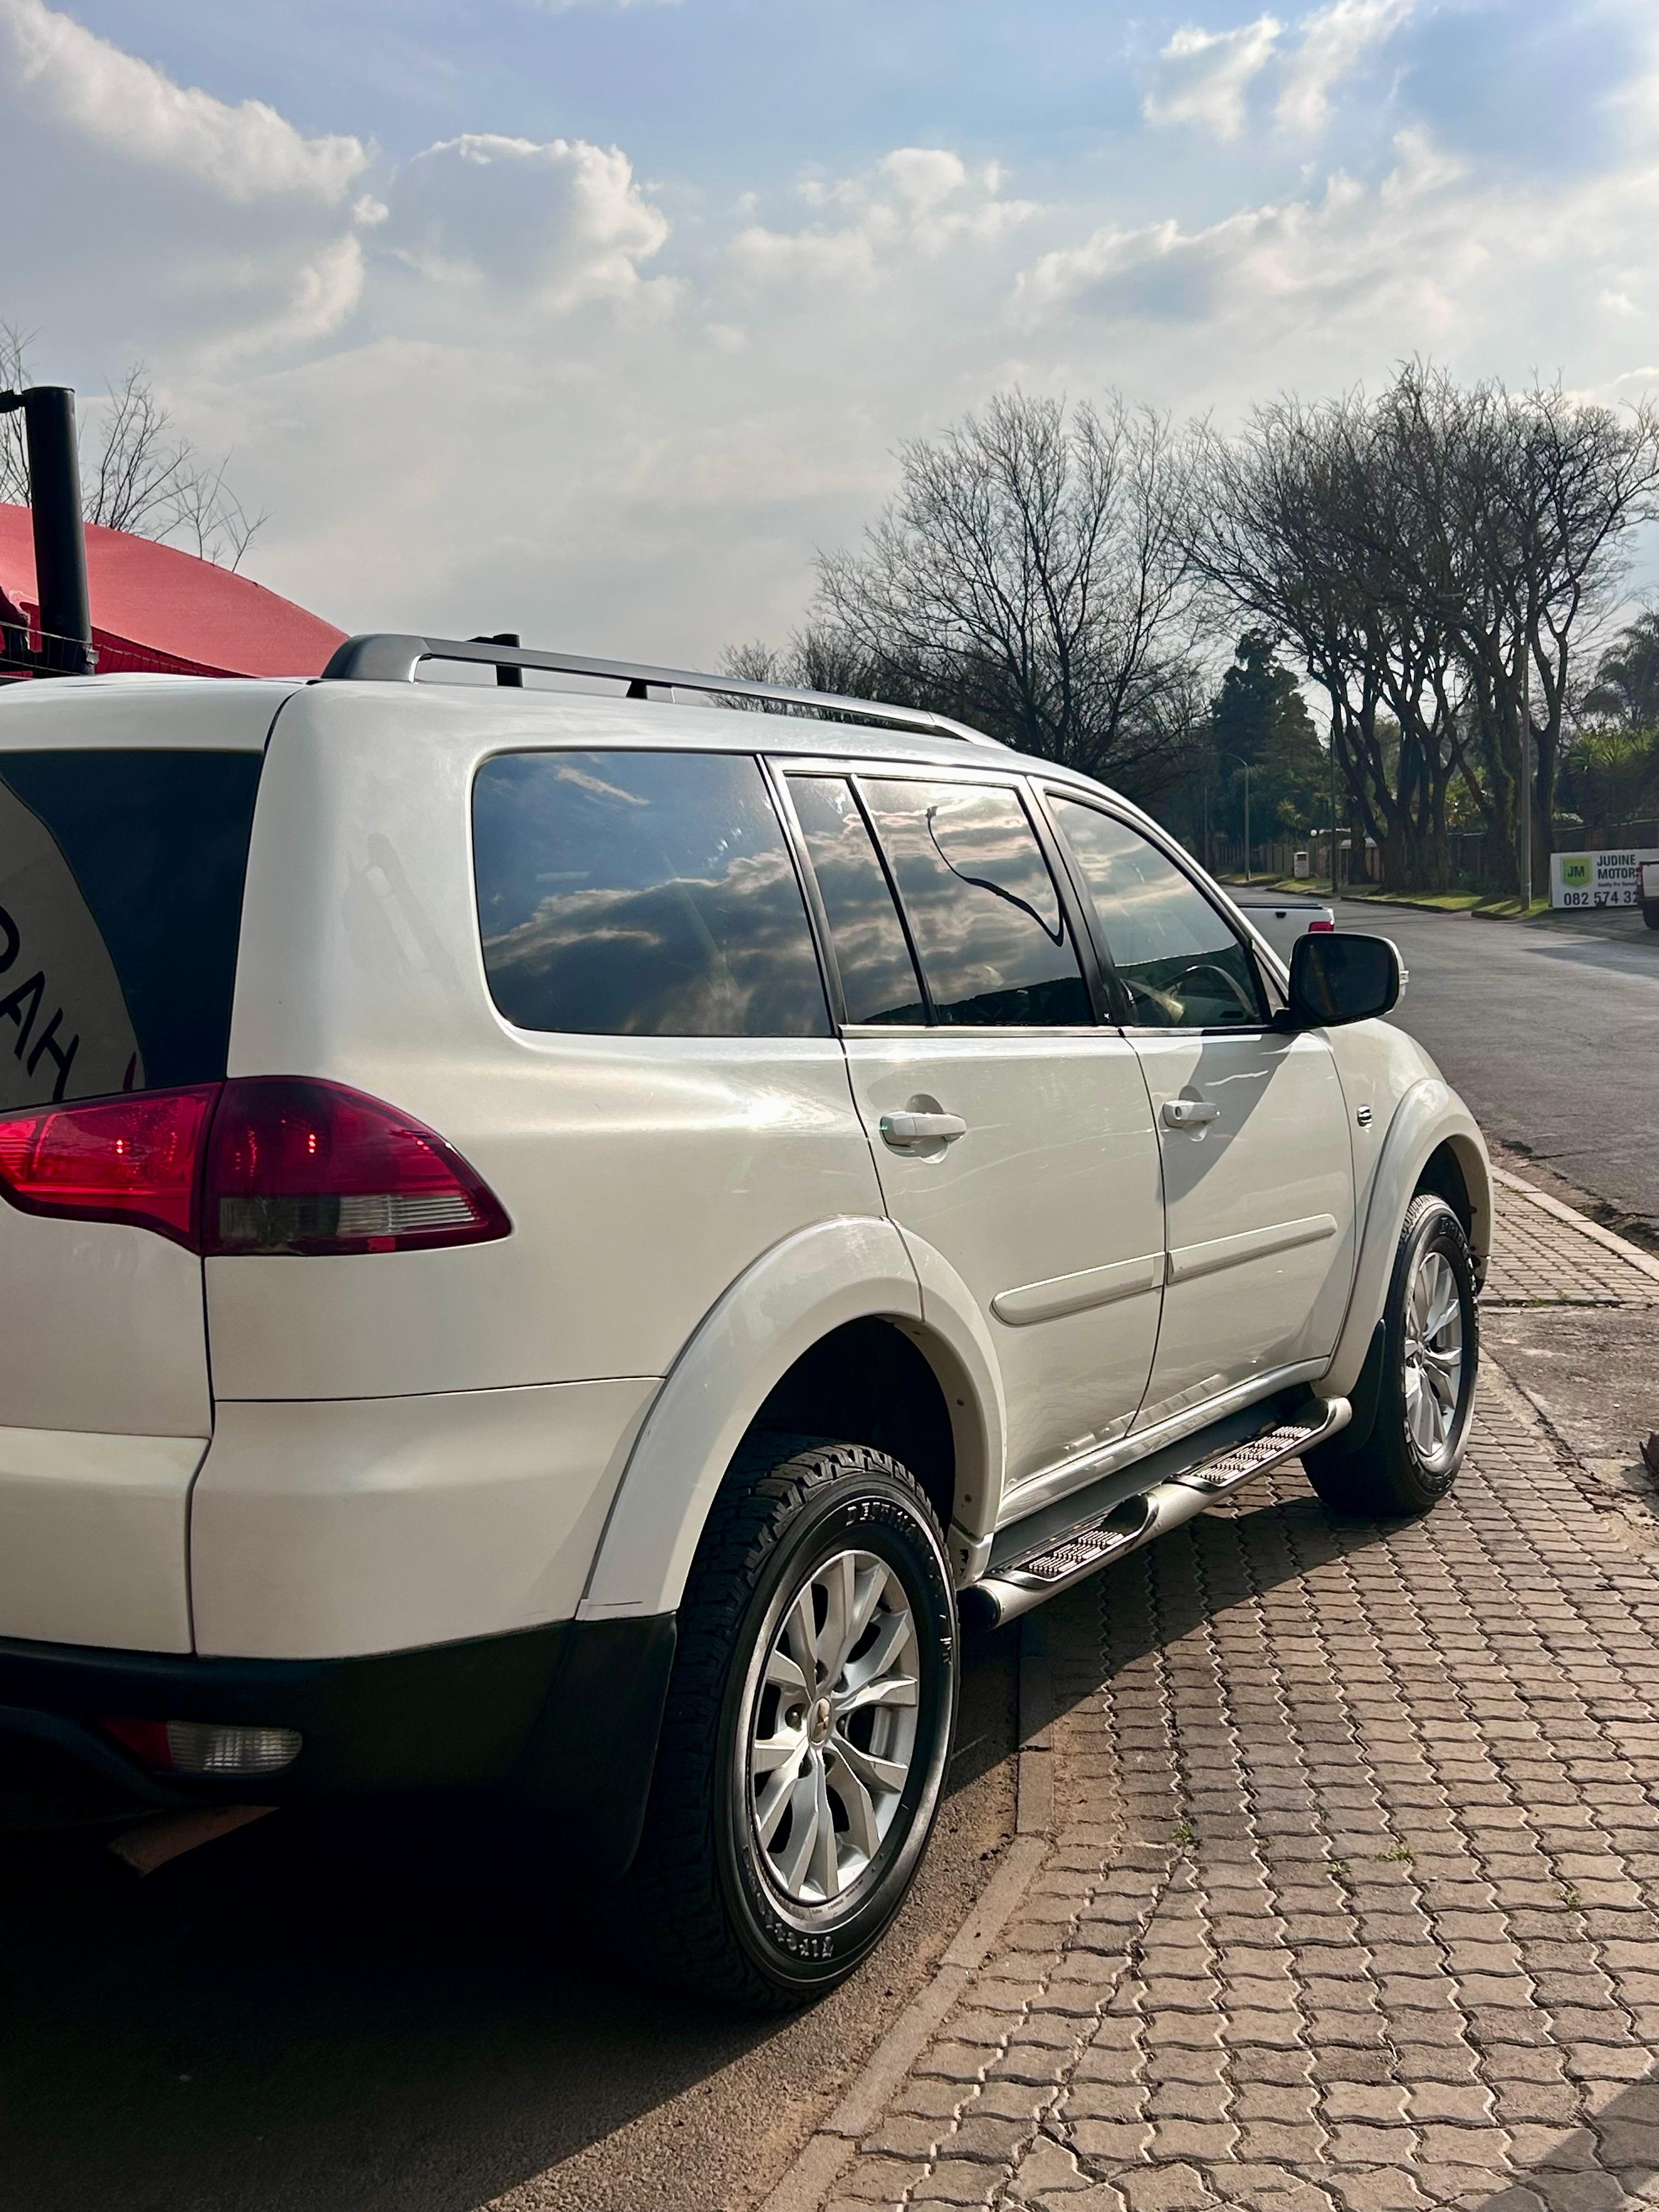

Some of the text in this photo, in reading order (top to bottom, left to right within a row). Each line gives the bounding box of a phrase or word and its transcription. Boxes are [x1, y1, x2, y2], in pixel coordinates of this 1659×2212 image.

[1597, 854, 1636, 866] JUDINE
[1568, 866, 1585, 877] JM
[1564, 893, 1589, 905] 082
[1594, 891, 1619, 904] 574
